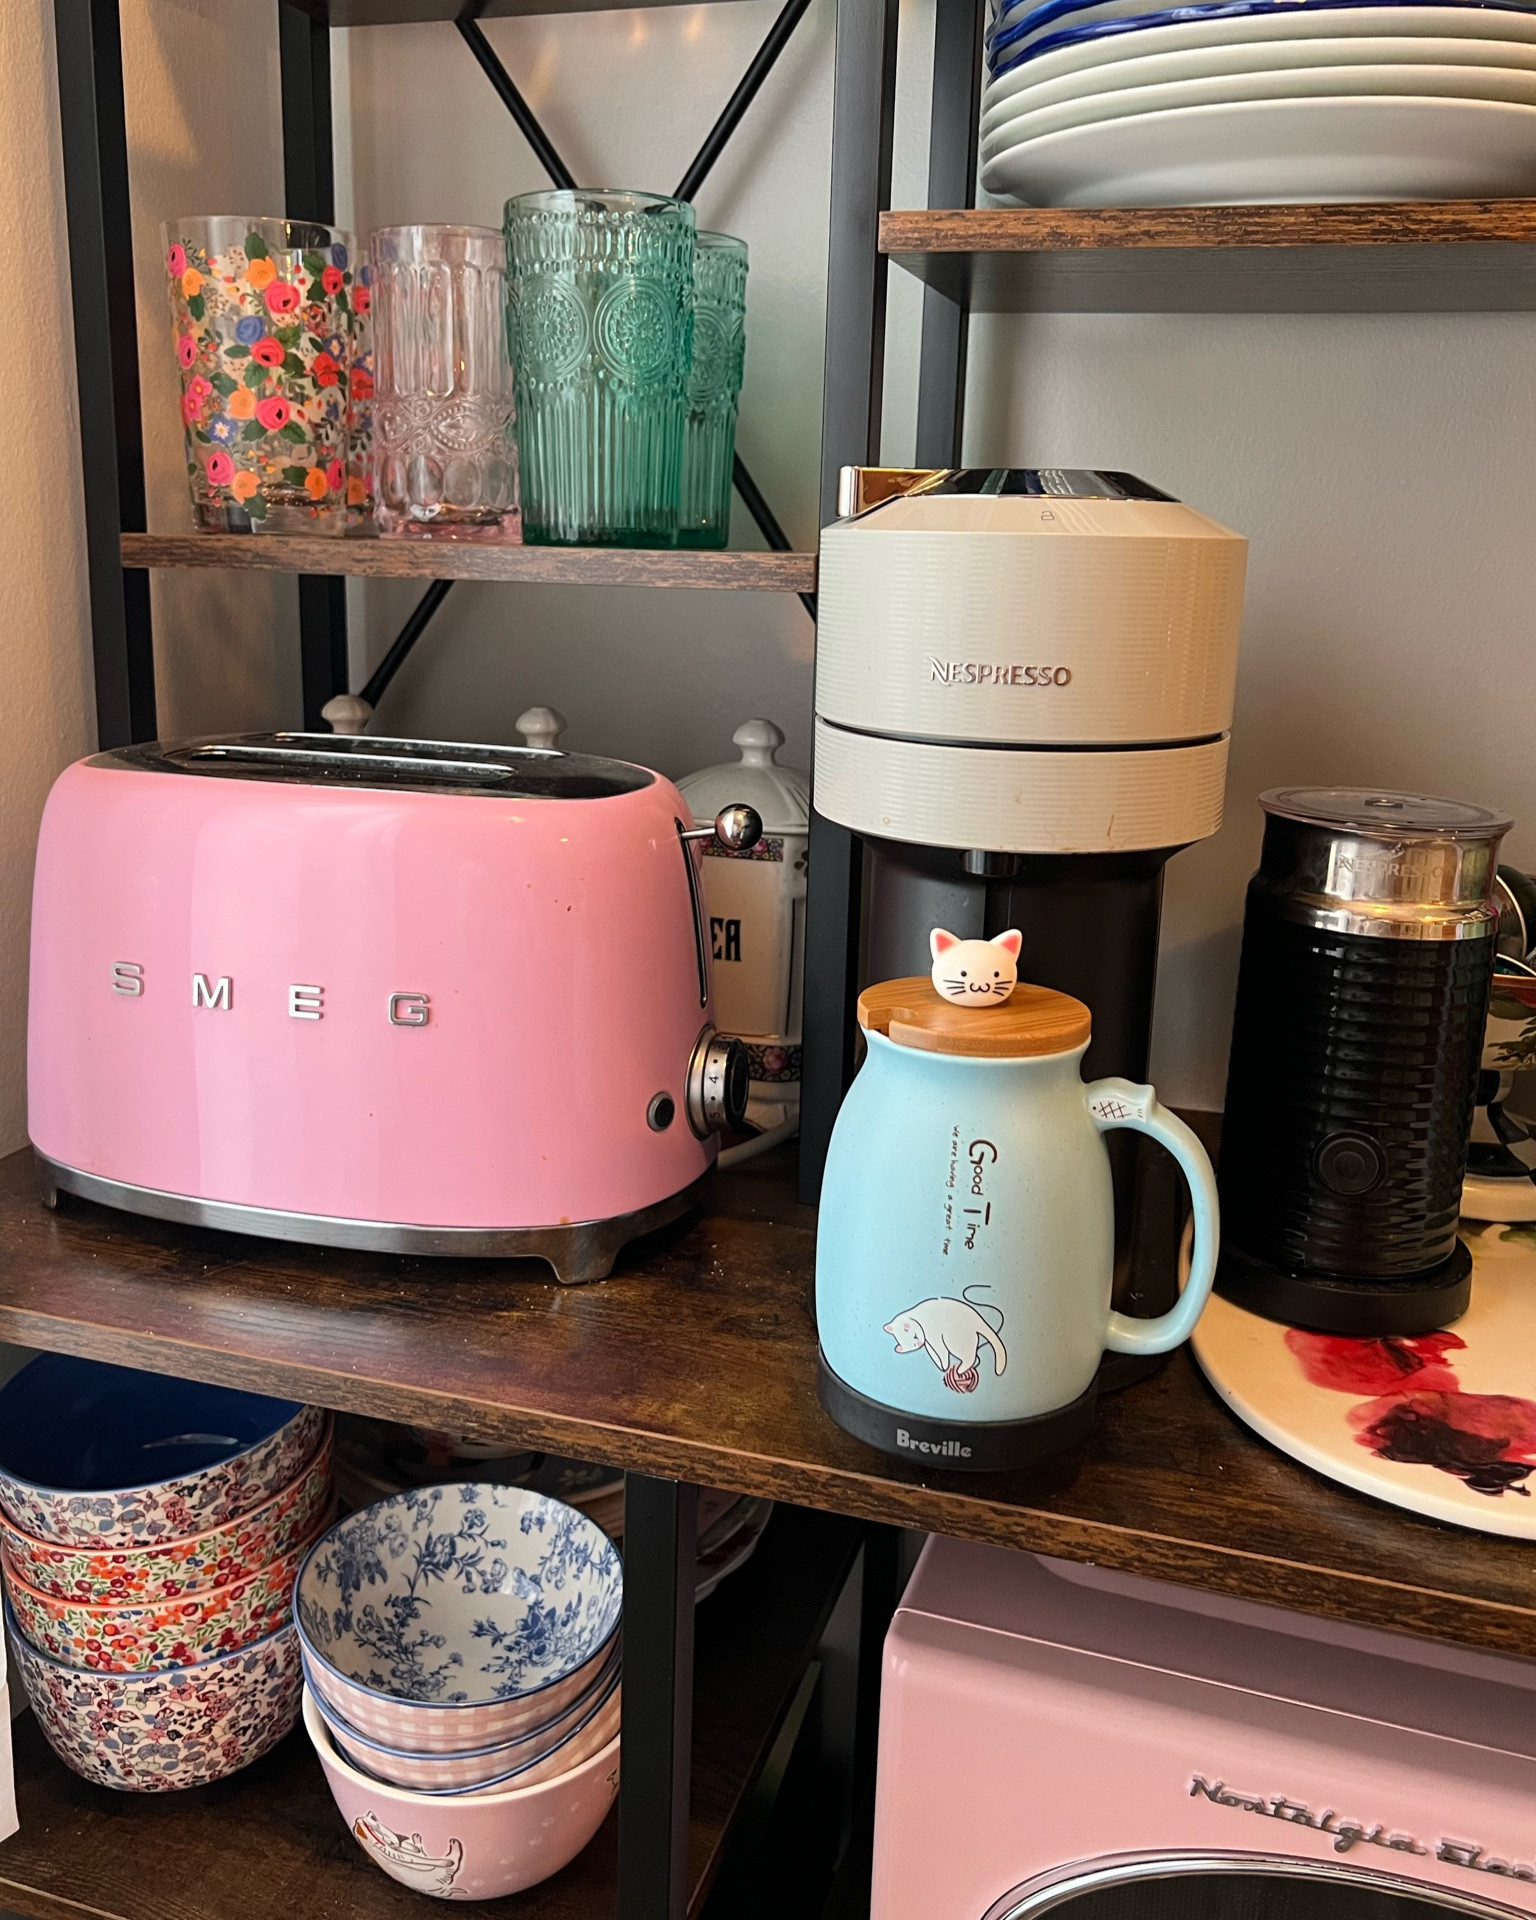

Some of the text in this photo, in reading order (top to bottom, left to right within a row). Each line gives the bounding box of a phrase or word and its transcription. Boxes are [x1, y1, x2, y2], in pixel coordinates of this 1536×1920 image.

[928, 655, 1072, 686] NESPRESSO
[709, 916, 742, 962] EA
[708, 1074, 719, 1085] 4
[963, 1139, 998, 1250] Good Time
[896, 1428, 972, 1458] Breville
[1189, 1774, 1428, 1853] Nostalgia
